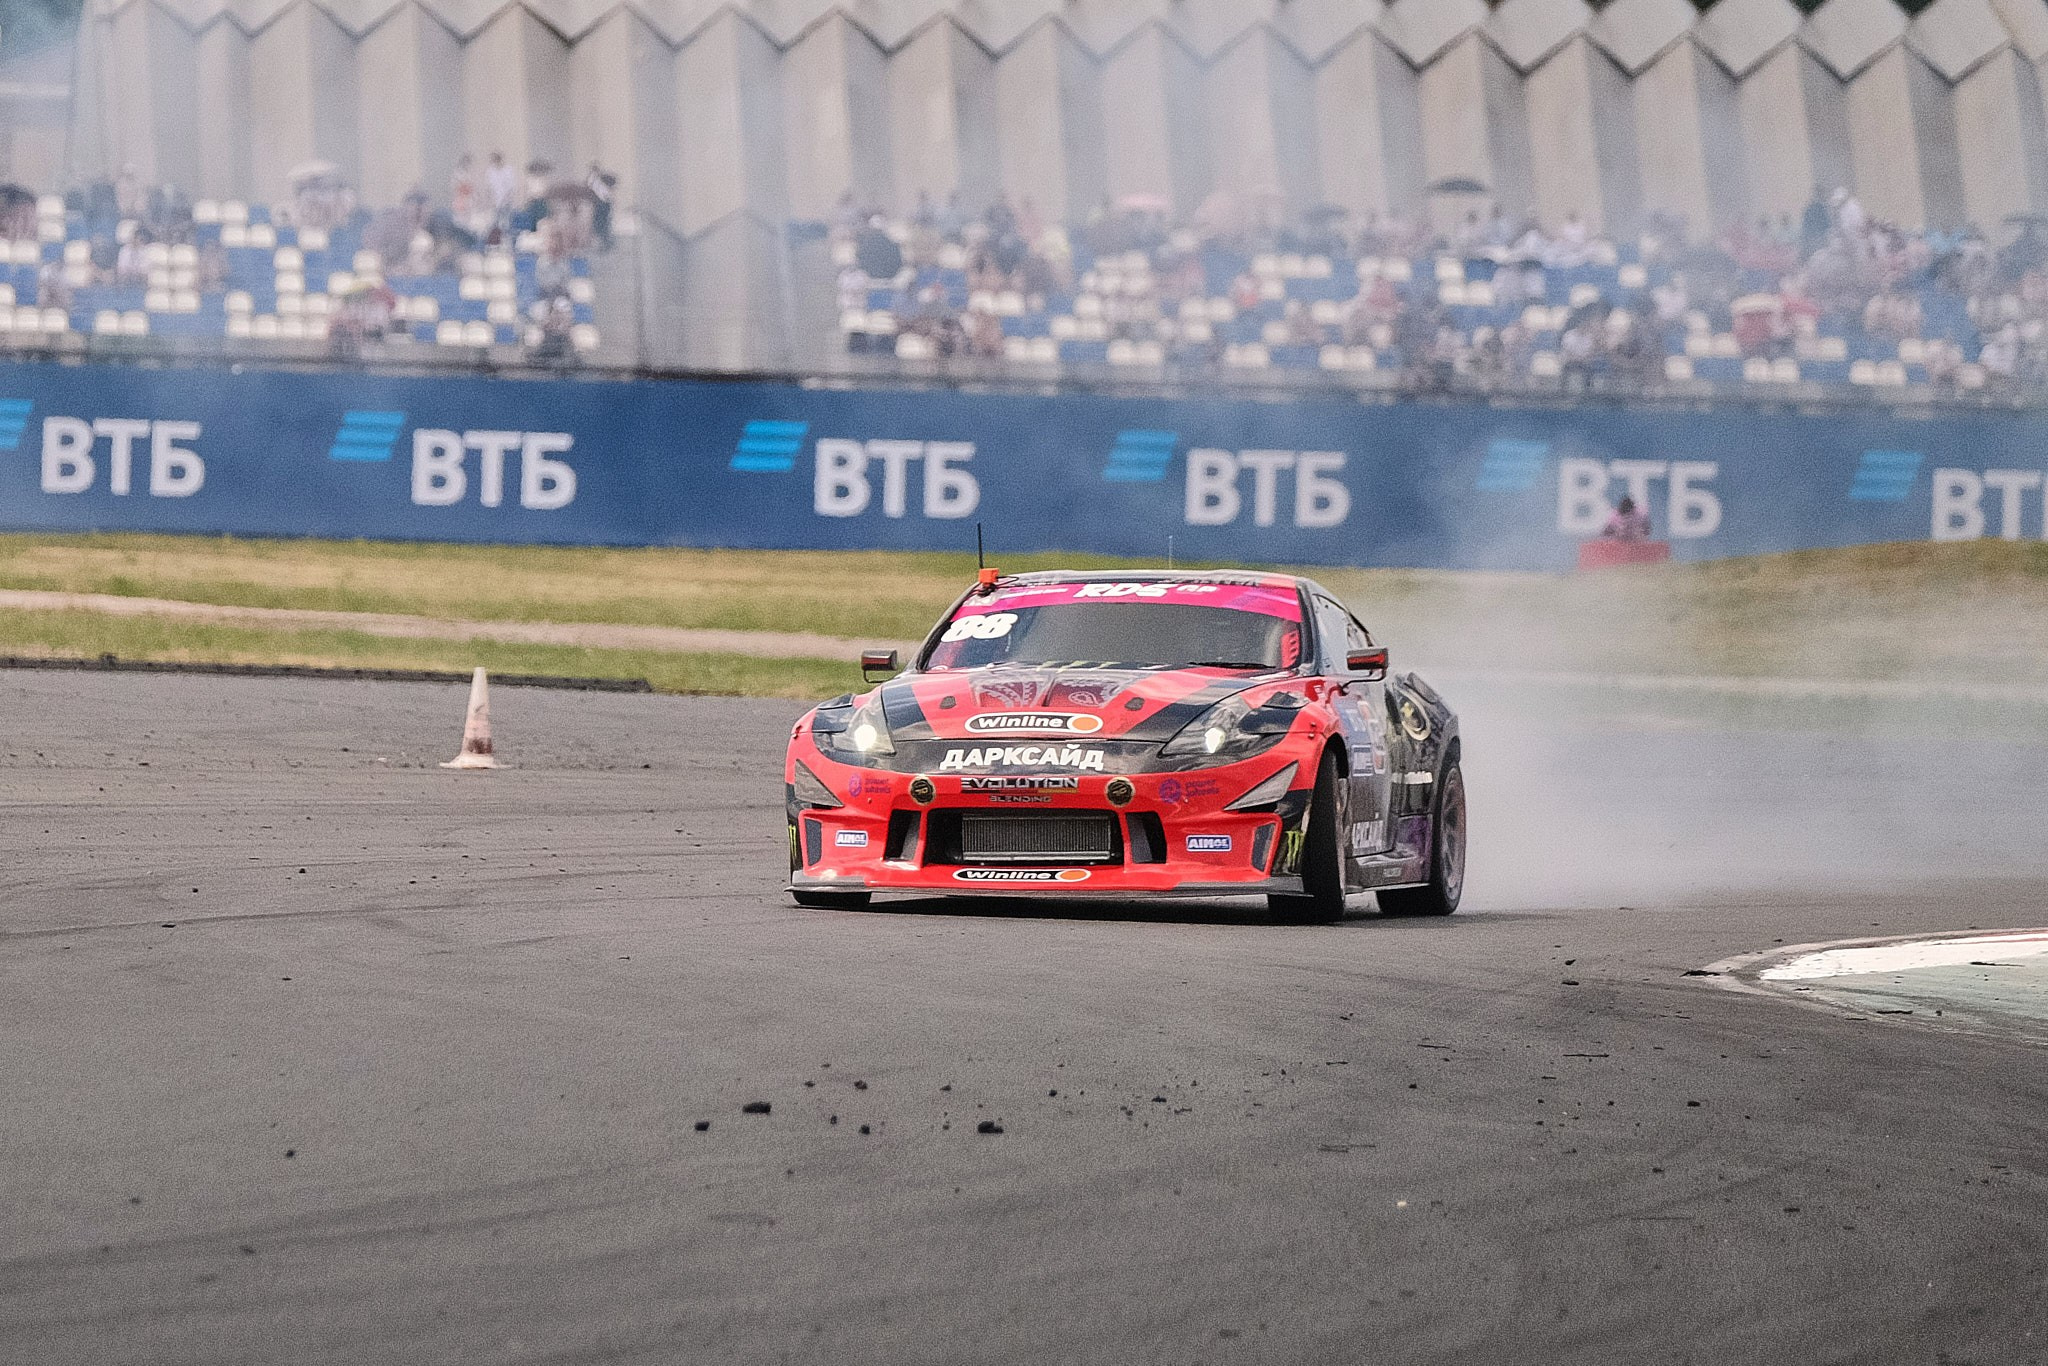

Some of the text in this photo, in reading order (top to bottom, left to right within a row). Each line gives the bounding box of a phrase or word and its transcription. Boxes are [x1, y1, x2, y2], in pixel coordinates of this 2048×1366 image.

[41, 416, 205, 498] ВТБ
[411, 428, 577, 510] ВТБ
[814, 438, 981, 519] ВТБ
[1184, 448, 1351, 528] ВТБ
[1557, 457, 1722, 538] ВТБ
[1931, 468, 2048, 541] ВТ
[941, 613, 1018, 643] 88
[1073, 583, 1179, 598] RDS
[939, 744, 1105, 771] ДАРКСАЙД
[961, 777, 1079, 789] EVOLUTION
